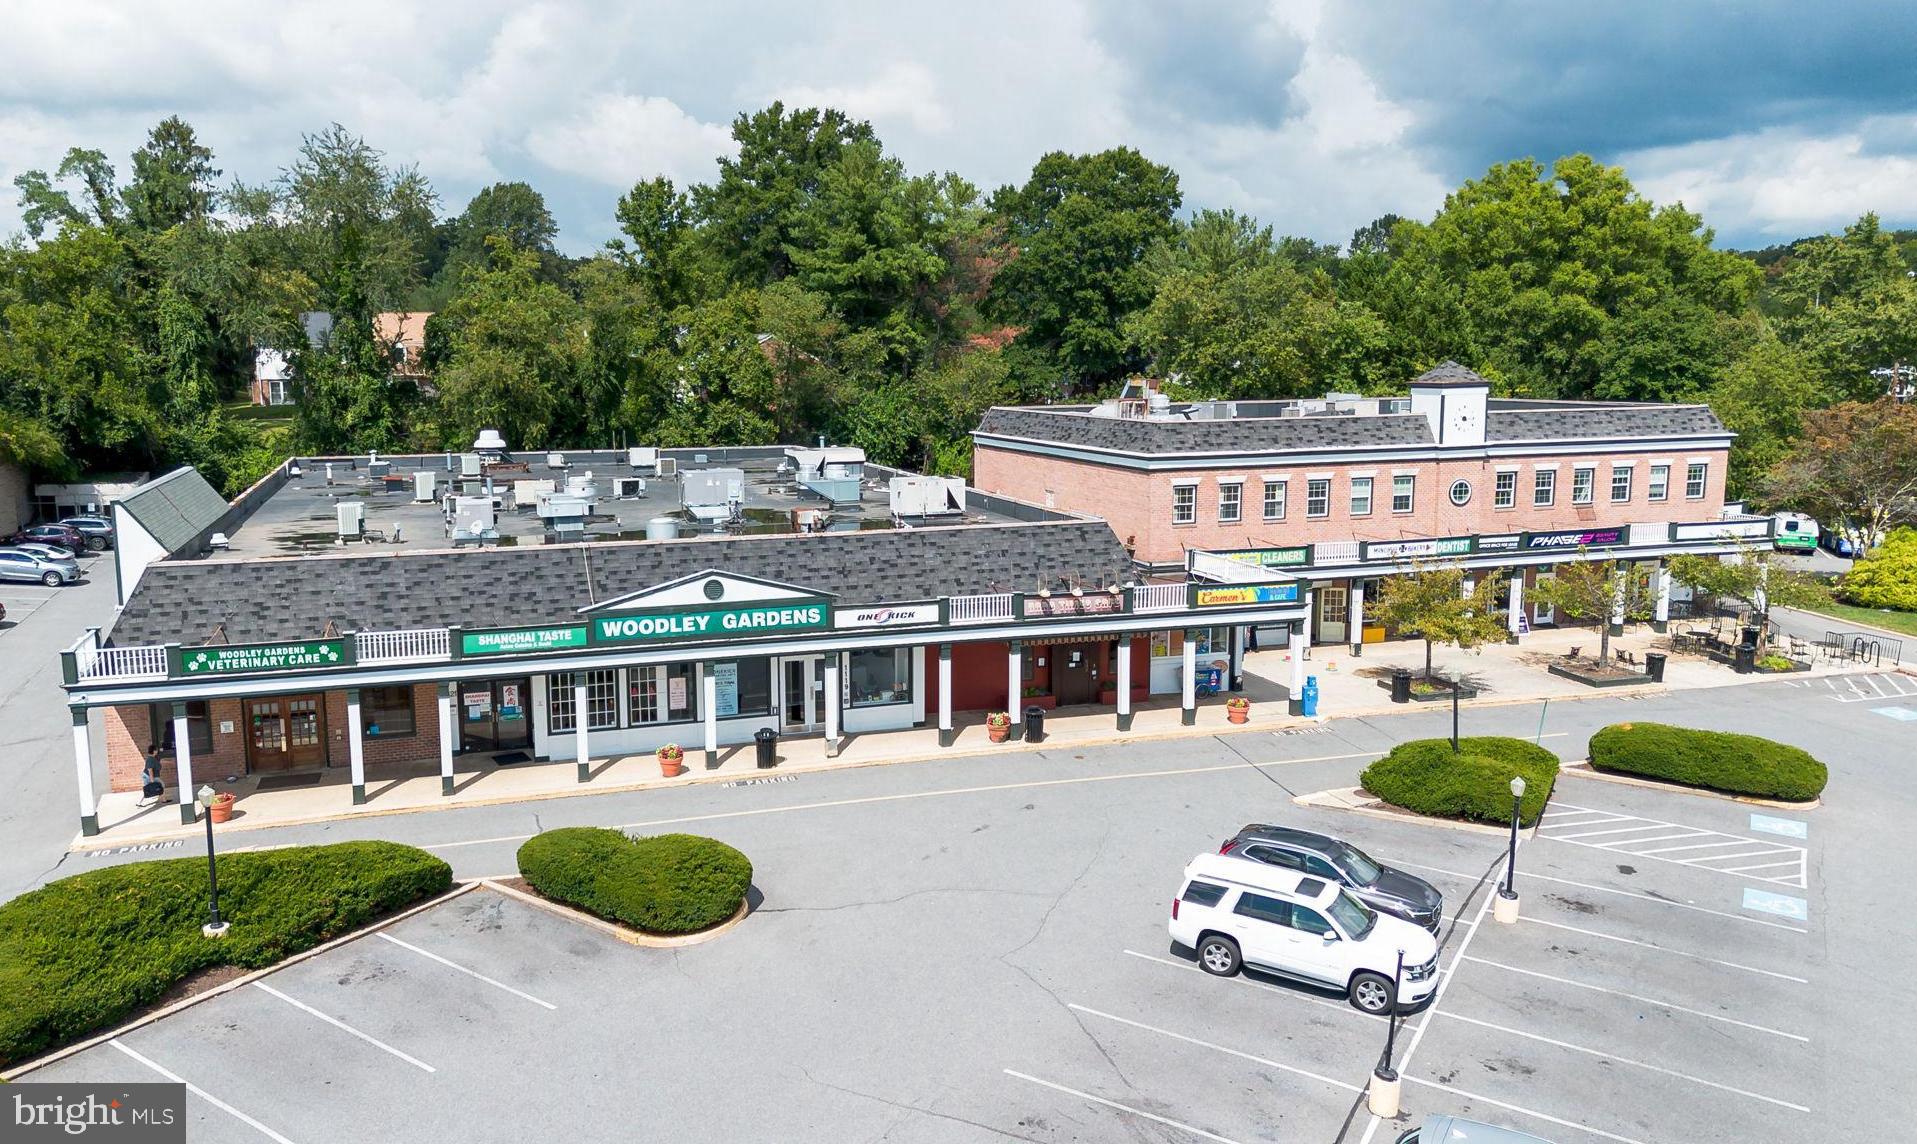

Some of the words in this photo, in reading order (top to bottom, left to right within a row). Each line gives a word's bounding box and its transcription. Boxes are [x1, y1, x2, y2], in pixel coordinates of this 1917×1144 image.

[1437, 540, 1468, 553] DENTIST
[1262, 550, 1304, 564] CLEANERS
[1202, 590, 1246, 604] Carmen's
[602, 615, 710, 637] WOODLEY
[722, 608, 821, 629] GARDENS
[857, 613, 879, 621] ONE
[887, 611, 916, 620] KICK
[478, 631, 536, 645] SHANGHAI
[537, 629, 572, 641] TASTE
[219, 649, 263, 659] WOODLEY
[264, 646, 306, 656] GARDENS
[207, 655, 287, 670] VETERINARY
[288, 653, 320, 665] CARE
[91, 849, 111, 857] NO
[119, 840, 183, 854] PARKING
